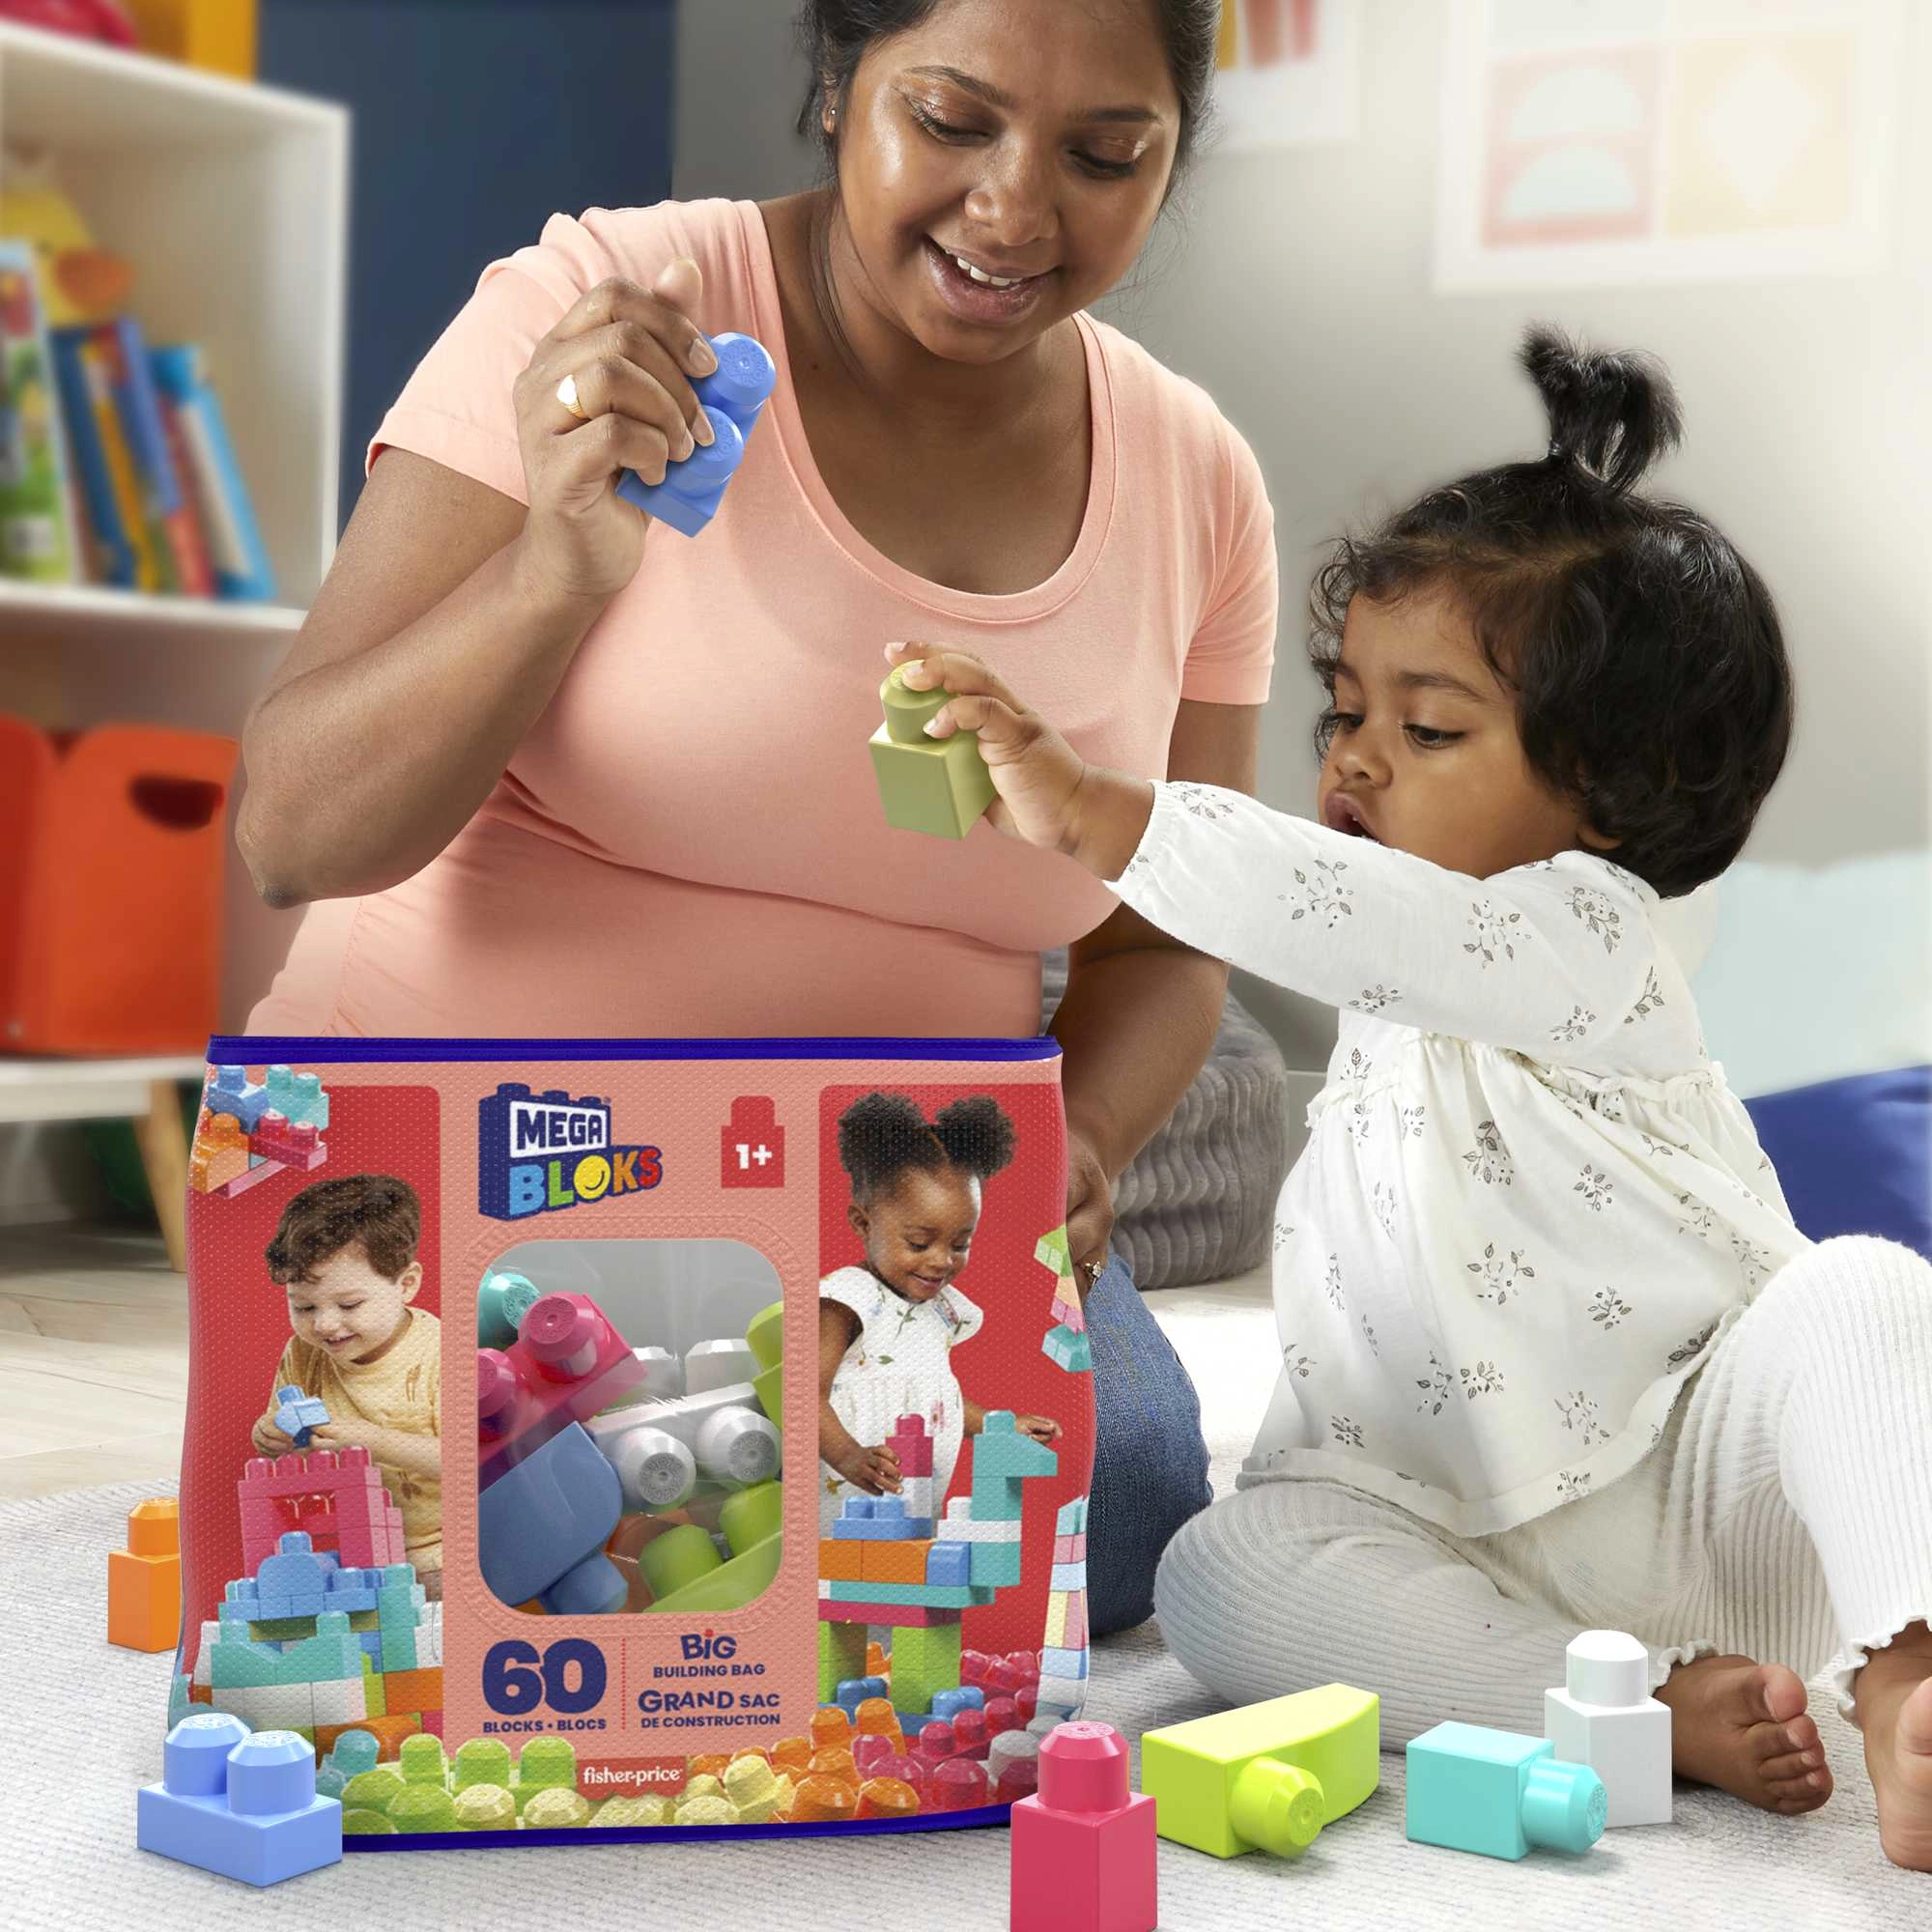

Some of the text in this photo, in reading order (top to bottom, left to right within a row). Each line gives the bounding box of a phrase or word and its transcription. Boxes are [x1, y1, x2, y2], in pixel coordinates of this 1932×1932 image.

[516, 1108, 604, 1151] MEGA
[735, 1144, 773, 1170] 1+
[508, 1148, 663, 1216] BLOKS
[482, 1637, 608, 1717] 60
[652, 1663, 766, 1679] BUILDING BAG
[638, 1690, 781, 1714] GRAND SAC
[482, 1719, 608, 1734] BLOCKS BLOCS
[640, 1713, 781, 1729] DE CONSTRUCTION
[582, 1766, 682, 1787] fisher-price
